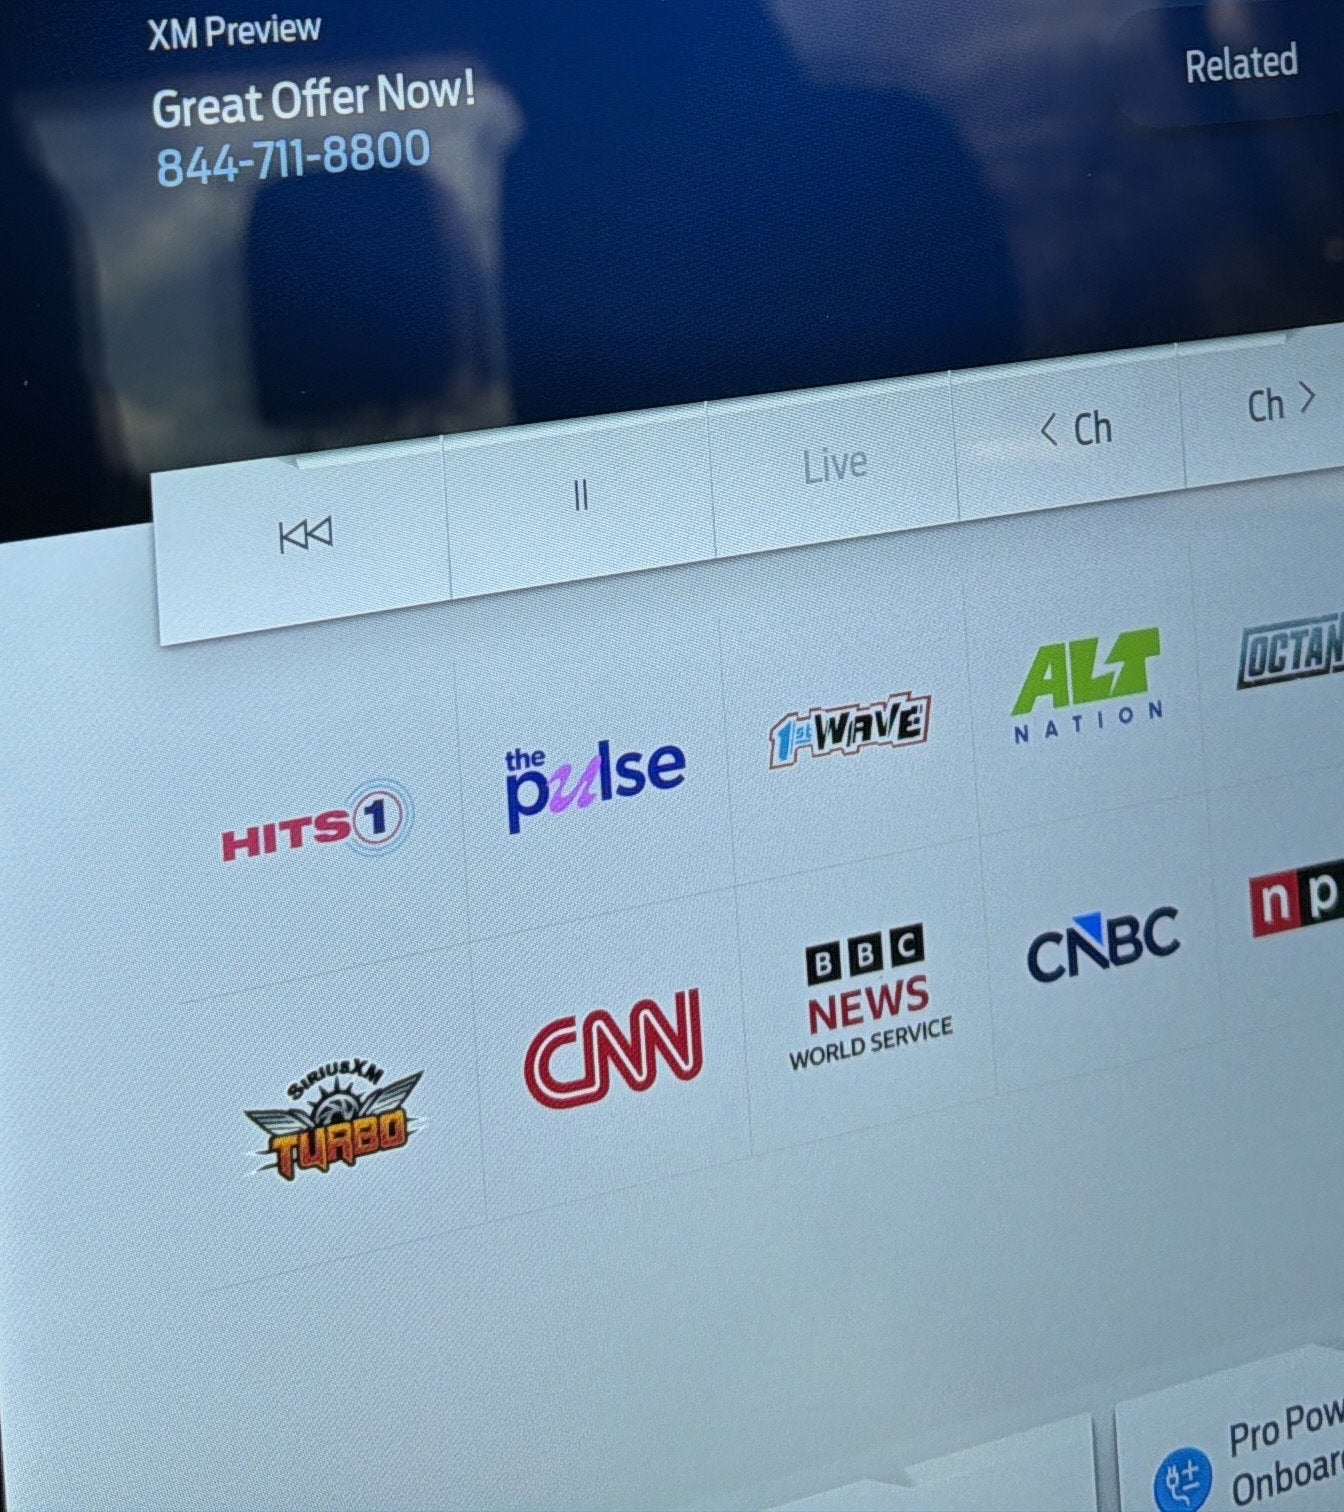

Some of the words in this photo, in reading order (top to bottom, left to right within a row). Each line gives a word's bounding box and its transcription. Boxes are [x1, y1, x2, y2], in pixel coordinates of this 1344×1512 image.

[147, 17, 198, 51] XM
[205, 14, 322, 48] Preview
[1185, 42, 1299, 85] Related
[152, 87, 263, 129] Great
[271, 76, 369, 120] Offer
[377, 68, 477, 112] Now!
[157, 128, 432, 188] 844-711-8800
[1074, 410, 1114, 447] Ch
[1247, 385, 1285, 423] Ch
[803, 448, 869, 486] Live
[1011, 628, 1161, 717] ALT
[813, 701, 924, 751] WAVE
[1014, 699, 1163, 745] NATION
[506, 747, 547, 772] the
[507, 740, 687, 835] pulse
[221, 808, 353, 863] HITS
[811, 929, 920, 980] BBC
[1026, 906, 1182, 984] CNBC
[808, 974, 930, 1036] NEWS
[523, 988, 704, 1110] CNN
[788, 1037, 867, 1072] WORLD
[870, 1015, 954, 1053] SERVICE
[269, 1107, 409, 1181] TURBO
[1229, 1422, 1281, 1459] Pro
